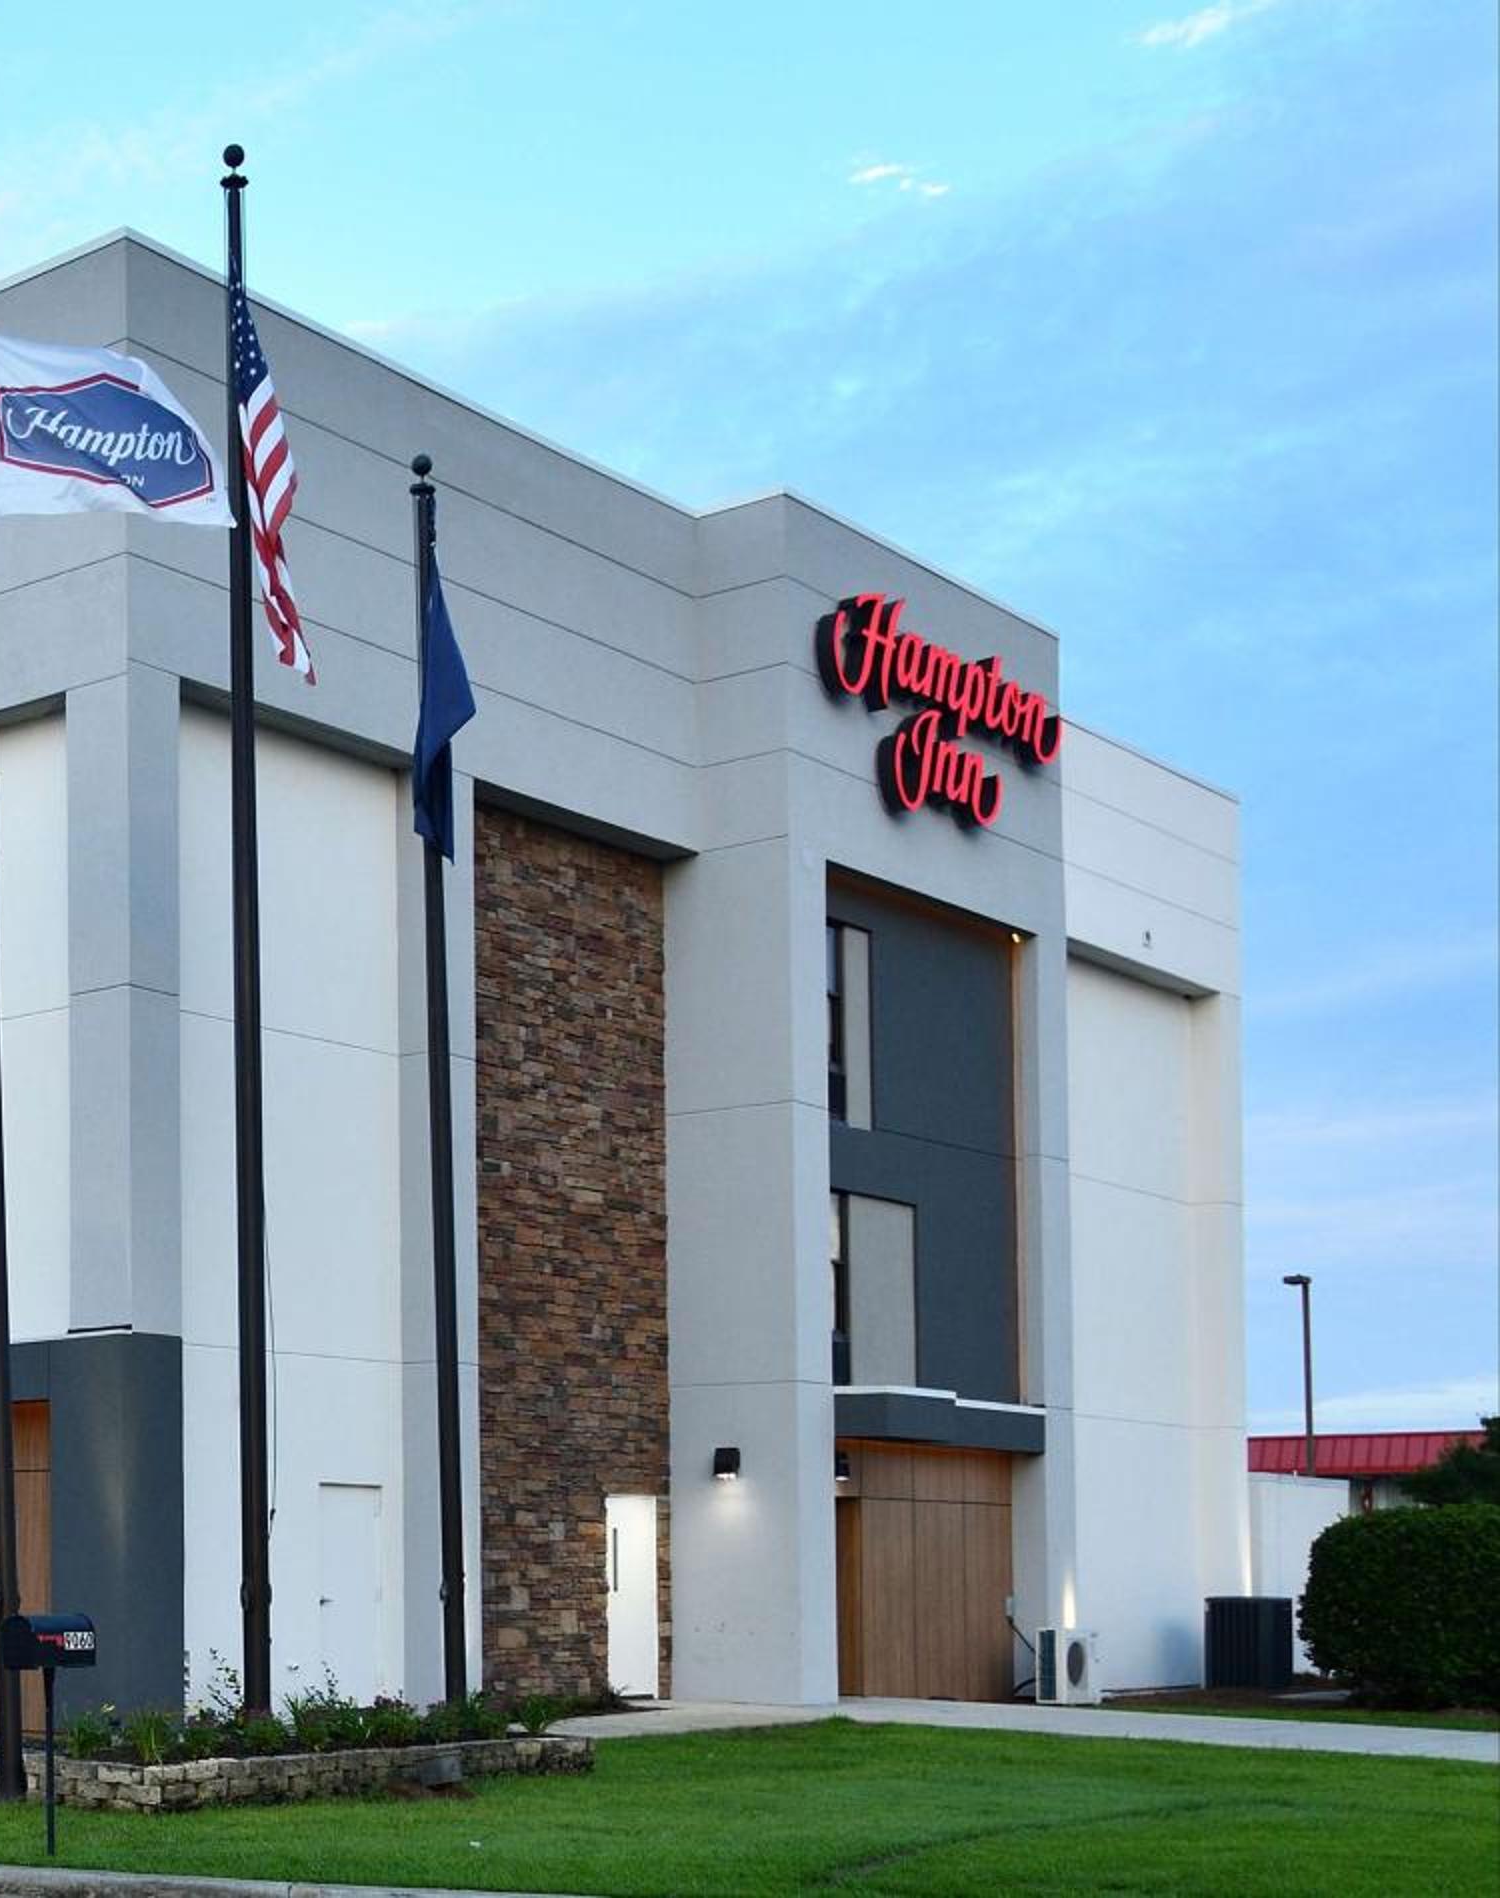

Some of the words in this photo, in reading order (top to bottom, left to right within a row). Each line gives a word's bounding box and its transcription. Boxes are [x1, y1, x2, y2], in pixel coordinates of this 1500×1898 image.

[6, 405, 197, 466] Hampton
[833, 592, 1063, 765] Hampton
[894, 709, 1003, 827] Inn
